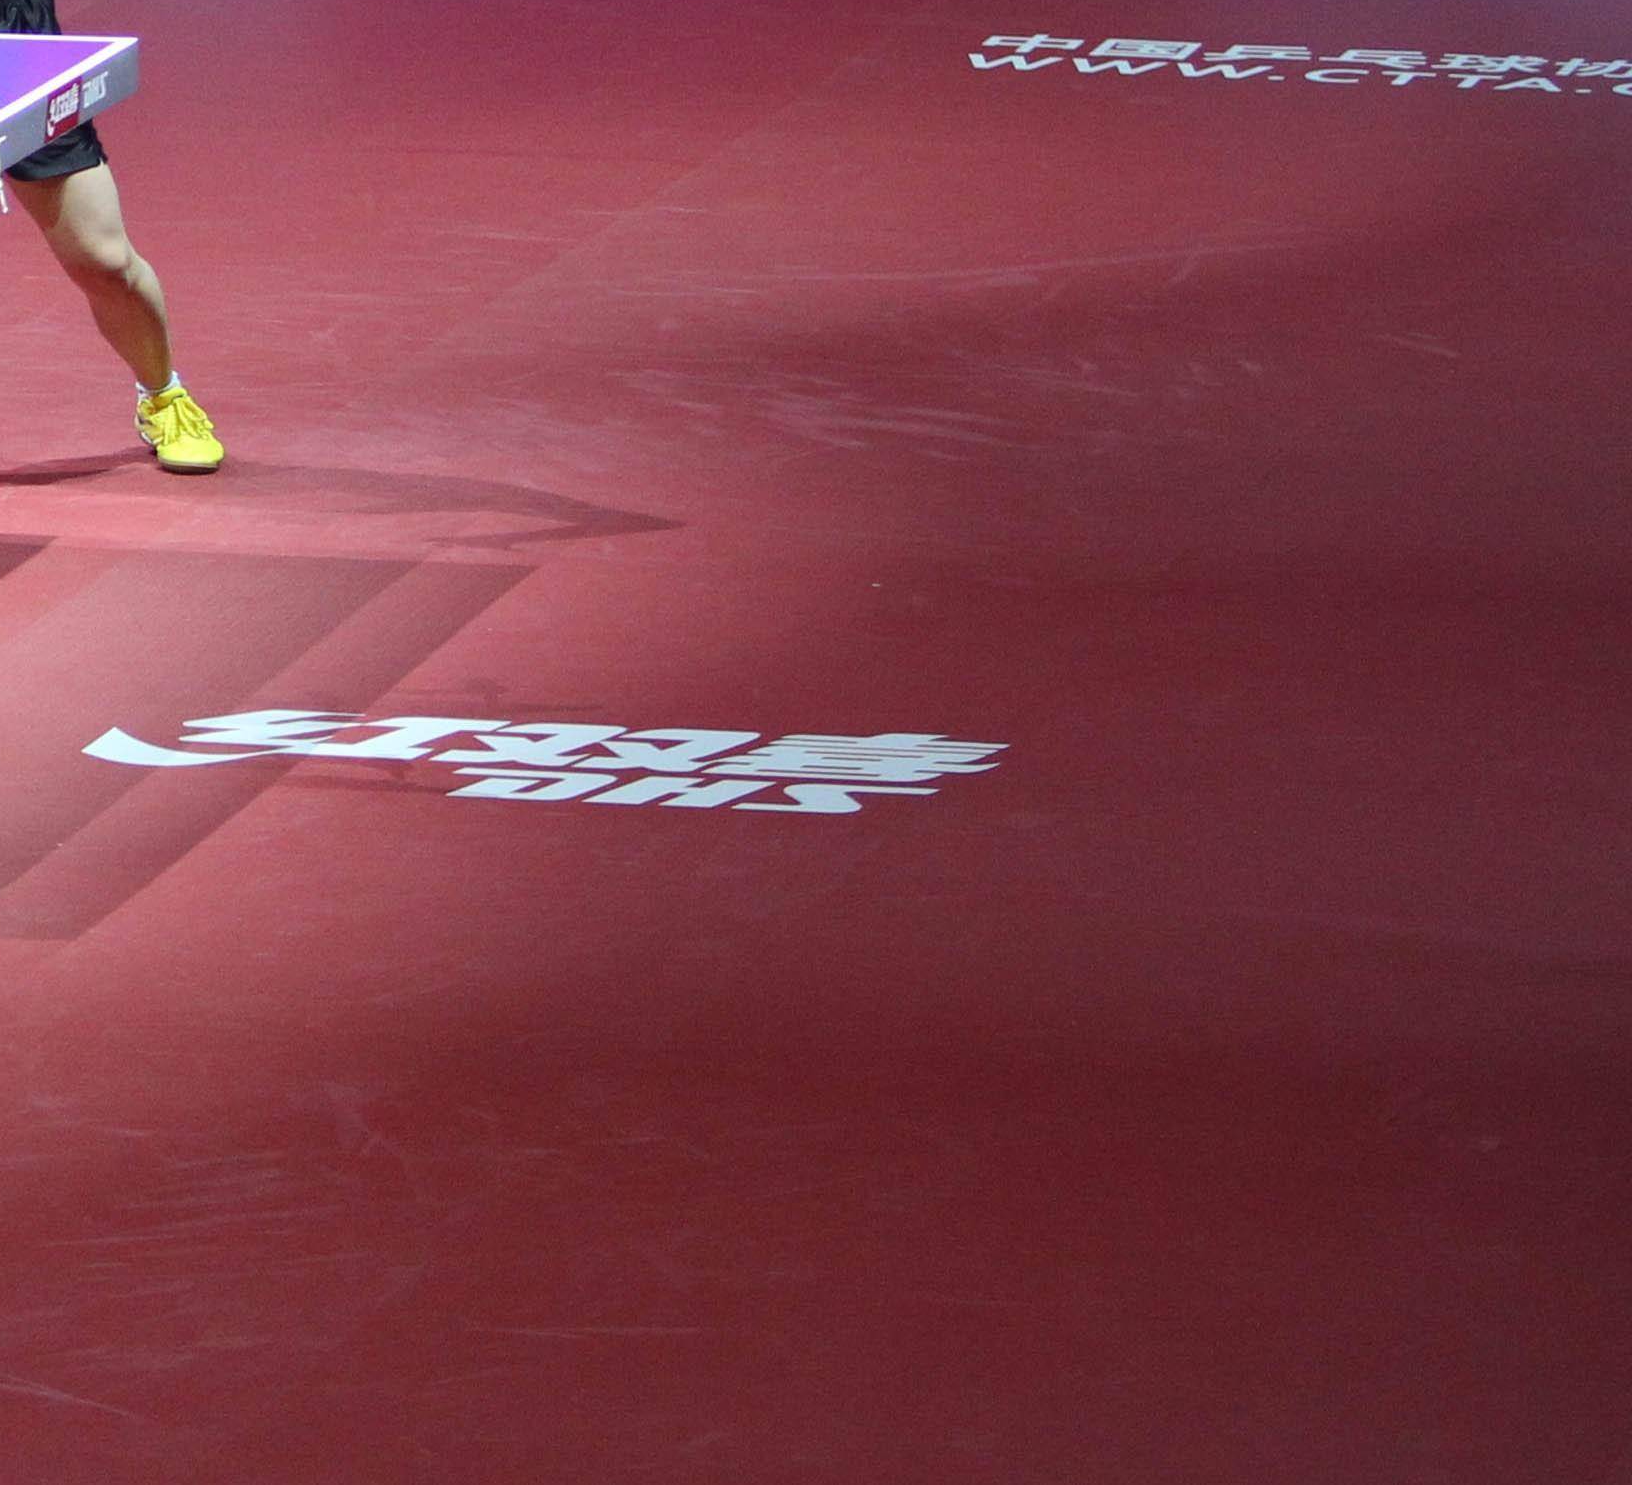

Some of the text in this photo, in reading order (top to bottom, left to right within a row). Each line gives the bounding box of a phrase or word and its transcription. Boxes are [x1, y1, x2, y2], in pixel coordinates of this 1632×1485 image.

[81, 708, 1012, 782] 红双喜
[445, 766, 940, 815] DHS
